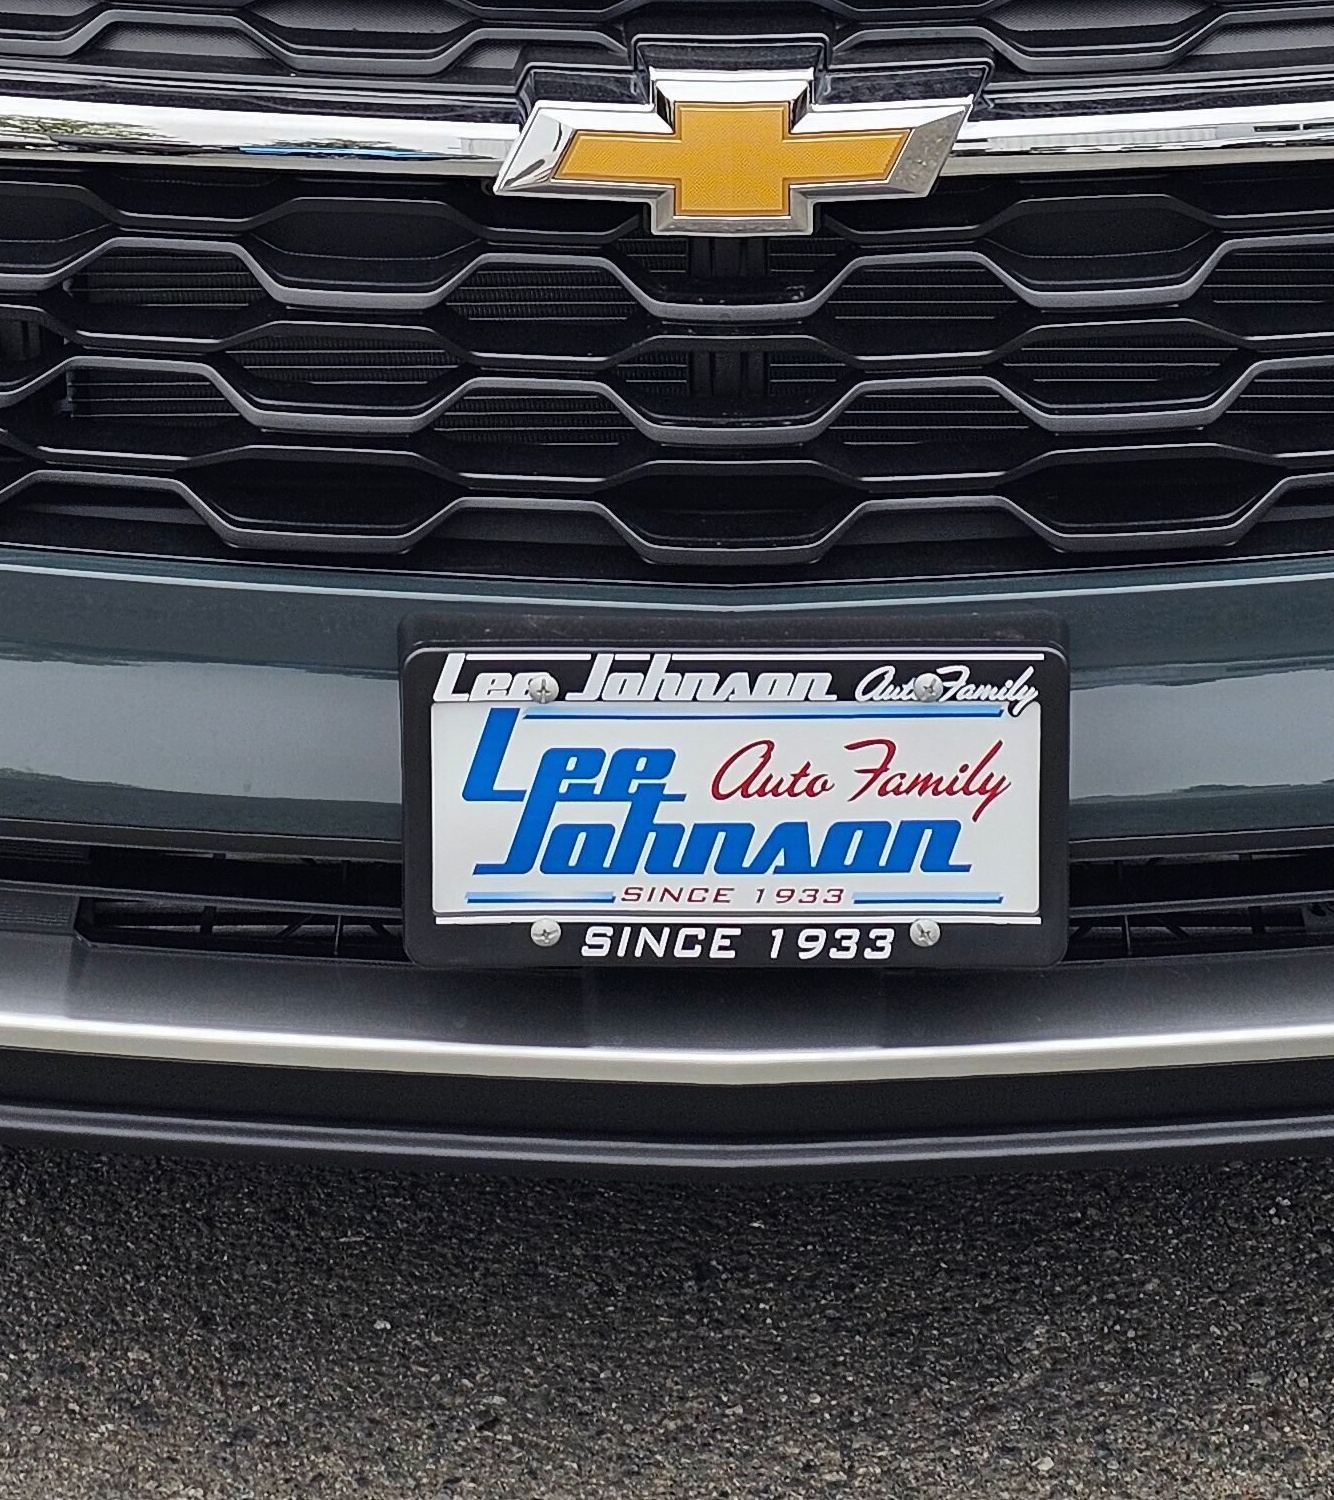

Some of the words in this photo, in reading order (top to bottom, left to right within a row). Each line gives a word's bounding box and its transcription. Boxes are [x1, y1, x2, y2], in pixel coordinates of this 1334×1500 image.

[565, 652, 838, 702] Johnson
[854, 664, 929, 702] Aut
[935, 664, 1039, 717] Family
[461, 707, 687, 802] Lee
[710, 739, 836, 801] Auto
[843, 738, 1012, 823] Family
[472, 792, 972, 876] Johnson
[620, 886, 736, 904] SINCE
[755, 887, 845, 904] 1933
[580, 926, 742, 959] SINCE
[769, 927, 895, 960] 1933
